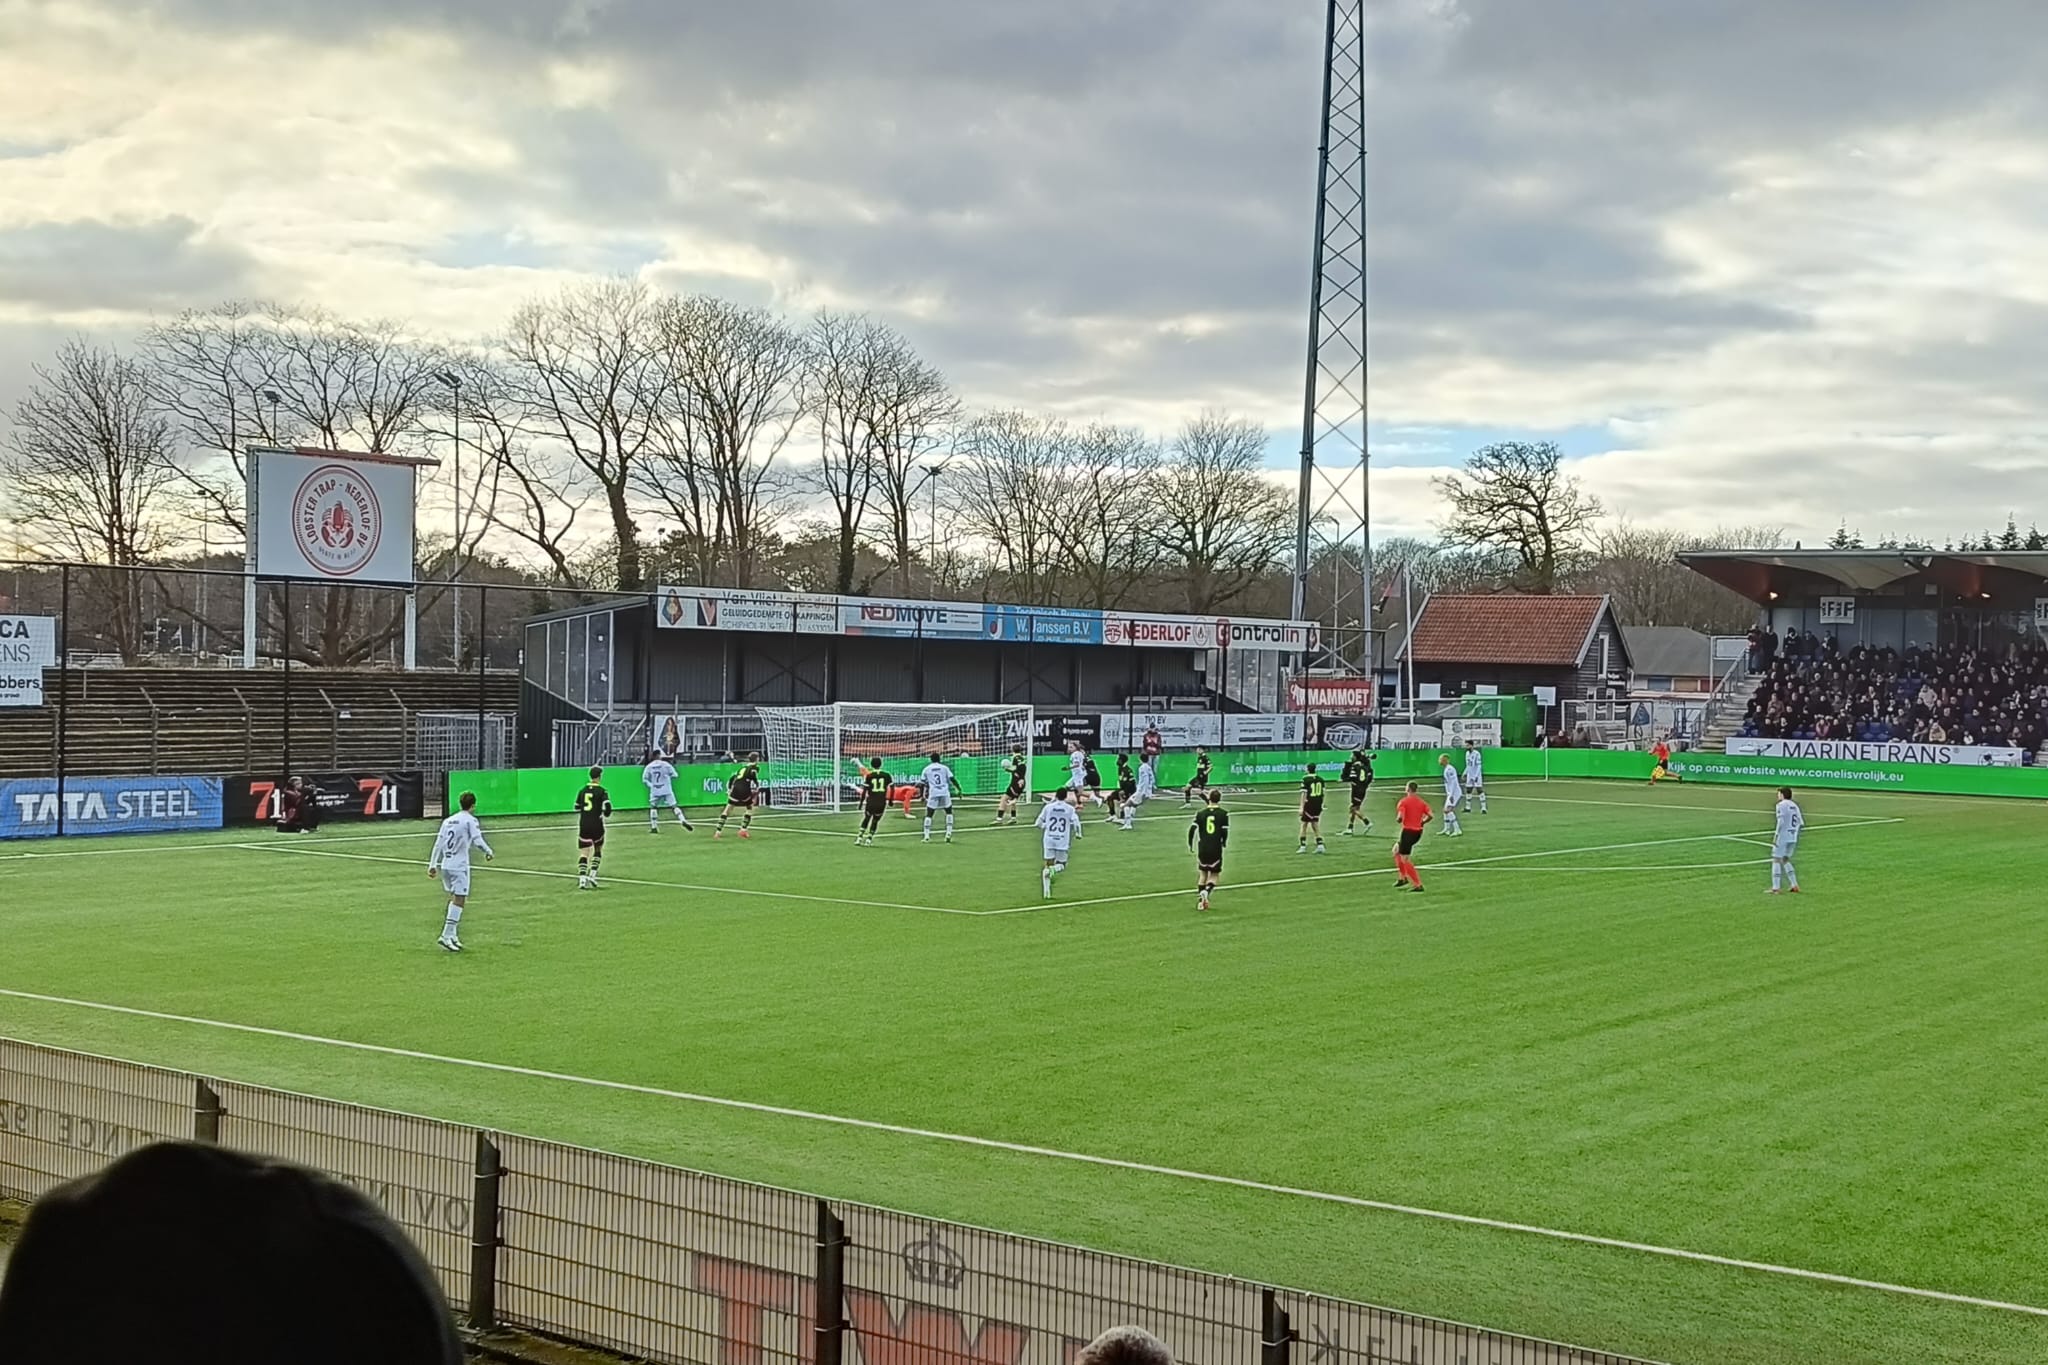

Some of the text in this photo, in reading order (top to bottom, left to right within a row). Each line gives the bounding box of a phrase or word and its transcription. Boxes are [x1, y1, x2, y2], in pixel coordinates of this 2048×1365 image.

[314, 478, 336, 498] TRAP
[345, 482, 371, 532] NEDERLOF
[304, 496, 319, 545] LOBSTER
[356, 532, 368, 549] BV
[723, 591, 746, 605] Van
[722, 608, 782, 619] GELUIDGEDEMPTE
[861, 603, 948, 623] NEDMOVE
[1016, 618, 1091, 635] W. Janssen B.V.
[1123, 624, 1192, 641] NEDERLOF
[1308, 688, 1369, 706] MAMMOET
[1006, 720, 1052, 736] ZWART
[1782, 742, 1951, 764] MARINETRANS
[654, 771, 661, 784] 7
[933, 774, 941, 785] 3
[1668, 762, 1904, 782] Kijk op onze website www.cornelisvrolijk.eu
[703, 778, 723, 794] Kijk
[871, 778, 885, 792] 11
[1310, 782, 1322, 797] 10
[15, 790, 198, 822] TATA STEEL
[583, 793, 593, 811] 5
[1049, 816, 1066, 832] 23
[1205, 815, 1215, 834] 6
[447, 830, 455, 849] 2
